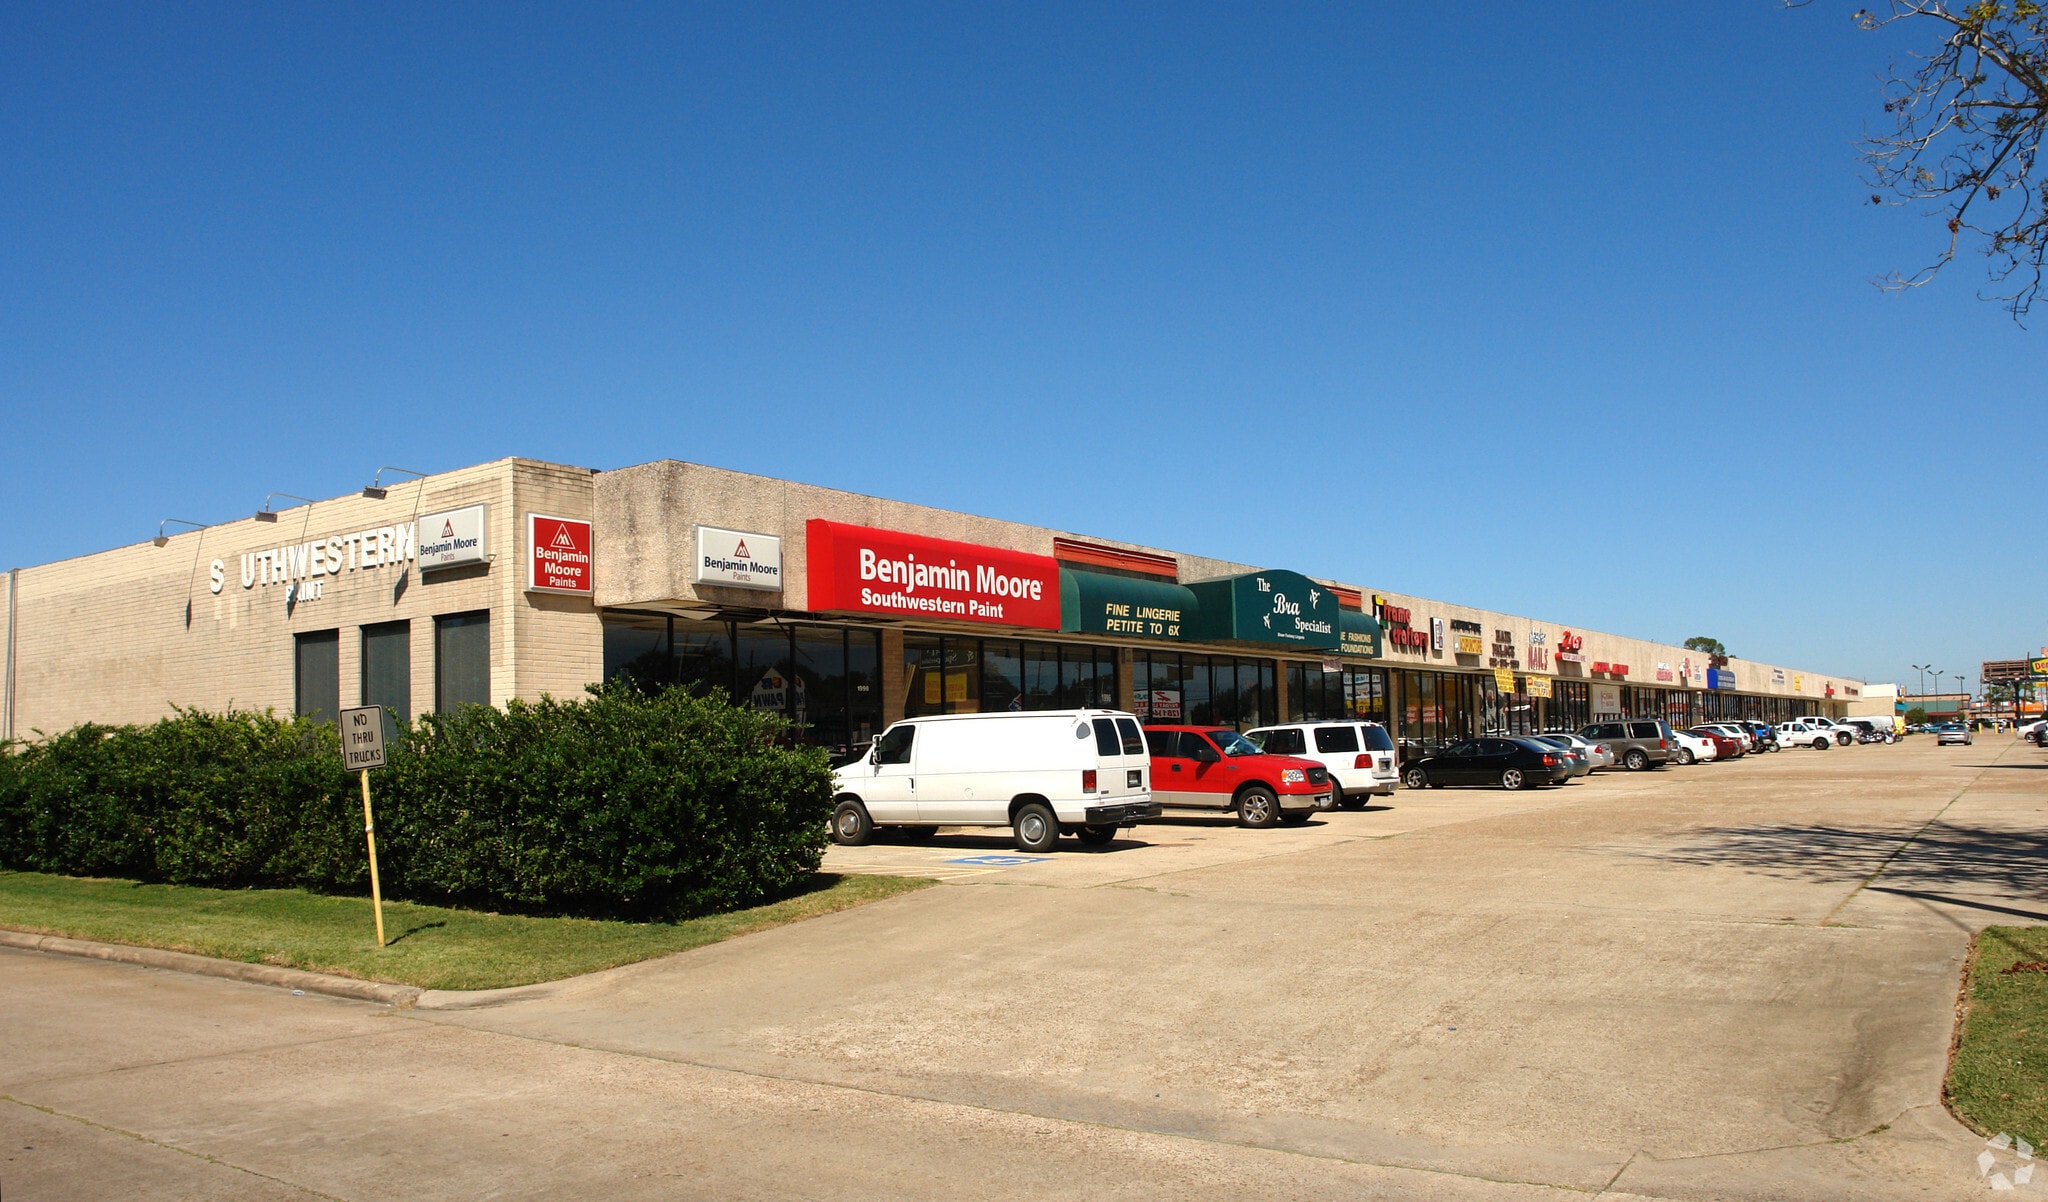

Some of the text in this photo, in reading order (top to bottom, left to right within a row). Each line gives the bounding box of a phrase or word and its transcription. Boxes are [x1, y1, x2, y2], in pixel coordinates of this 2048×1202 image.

[420, 537, 478, 557] Benjamin Moore
[440, 553, 455, 561] Paints
[536, 547, 589, 564] Benjamin
[545, 562, 582, 576] Moore
[704, 556, 778, 575] Benjamin Moore
[549, 576, 577, 588] Paints
[733, 571, 751, 581] Paints
[860, 548, 1043, 600] Benjamin Moore
[286, 580, 324, 601] PINT
[1256, 577, 1271, 592] The
[861, 587, 1004, 618] Southwestern Paint
[1273, 592, 1300, 615] Bra
[1105, 603, 1181, 622] FINE LINGERIE
[1106, 618, 1180, 637] PETITE TO 6X
[1294, 617, 1331, 634] Specialist
[1348, 632, 1372, 644] FASHIONS
[1341, 642, 1374, 655] FOUNDATIONS
[353, 713, 368, 727] NO
[352, 731, 374, 744] THRU
[349, 749, 381, 763] TRUCKS
